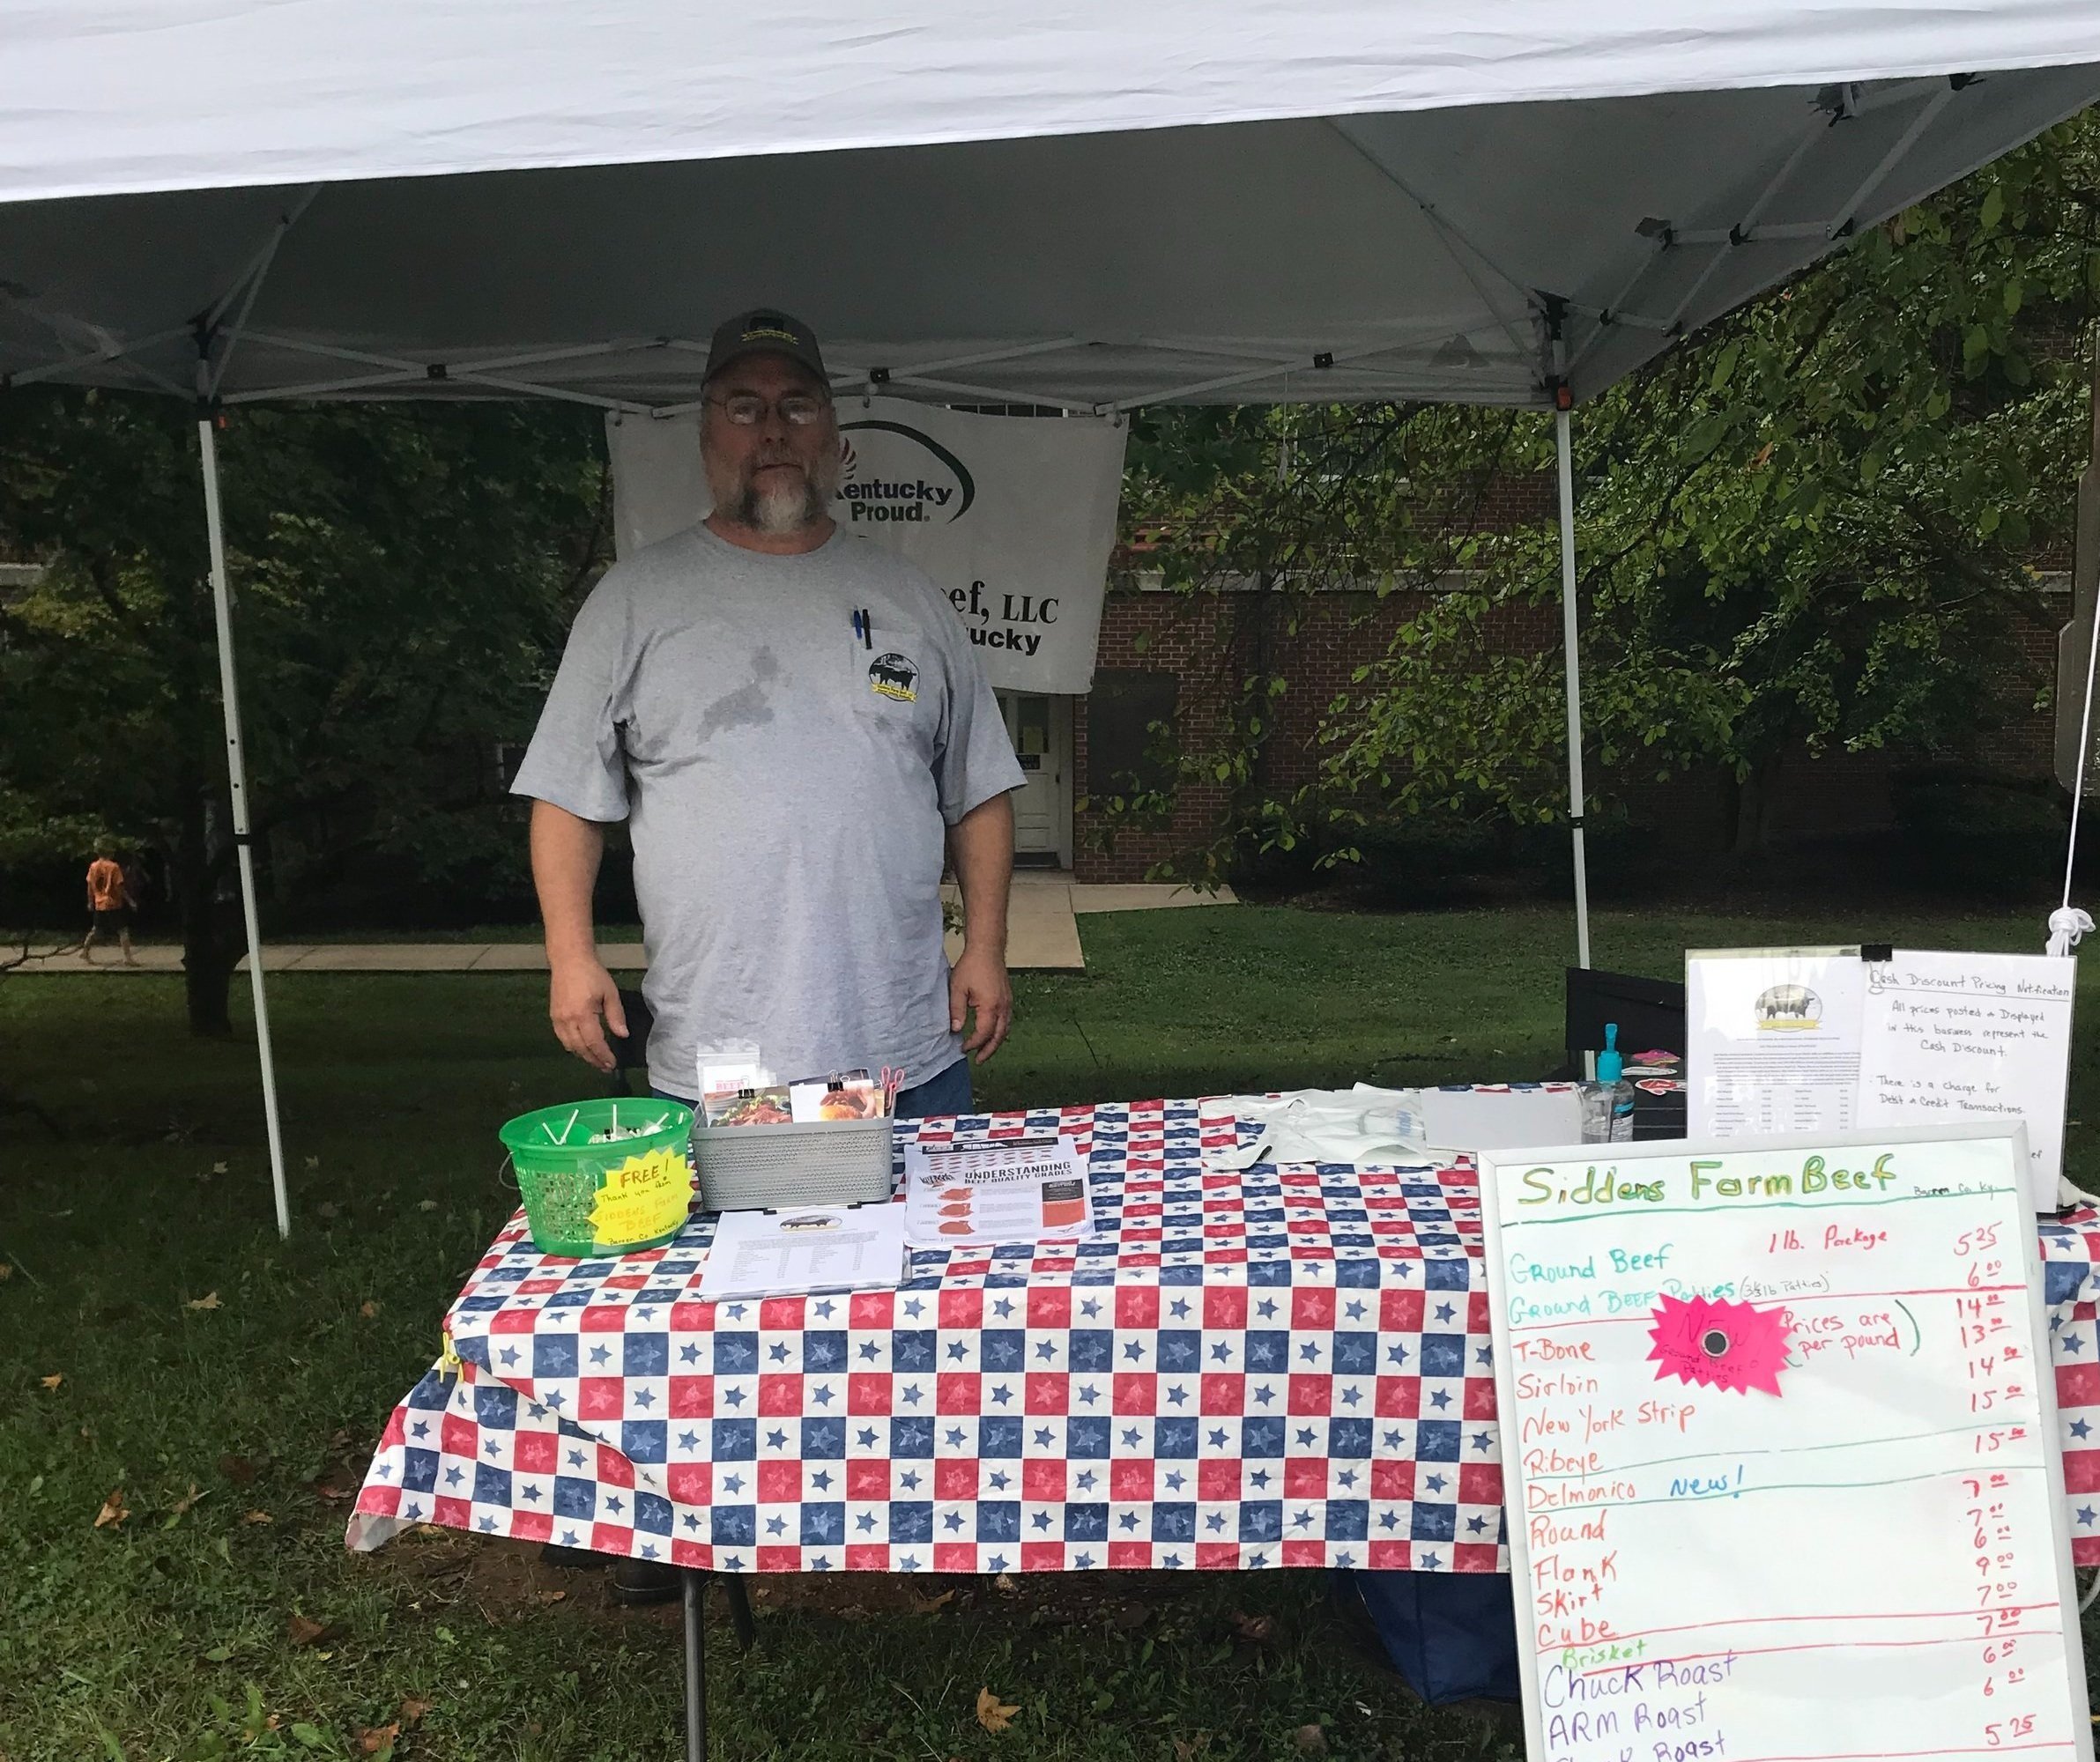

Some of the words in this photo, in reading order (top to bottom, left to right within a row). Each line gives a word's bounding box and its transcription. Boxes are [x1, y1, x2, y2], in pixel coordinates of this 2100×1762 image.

[1001, 594, 1058, 624] LLC
[966, 628, 1042, 655] ucky
[1870, 970, 1900, 986] Cash
[1906, 974, 1966, 988] Discount
[1971, 977, 2006, 995] Pricing
[1892, 1000, 1905, 1012] All
[1910, 1005, 1940, 1018] prices
[1946, 1006, 1981, 1018] posted
[2000, 1009, 2044, 1023] Displayed
[1933, 1025, 1972, 1037] business
[1983, 1030, 2025, 1040] represent
[2031, 1031, 2048, 1040] the
[1920, 1040, 1946, 1053] Cash
[1879, 1093, 1903, 1105] Debit
[1919, 1096, 1948, 1108] Credit
[1985, 1083, 2000, 1093] for
[965, 1161, 1071, 1180] UNDERSTANDING
[991, 1173, 1031, 1183] QUALITY
[1035, 1169, 1072, 1178] GRADES
[1517, 1166, 1666, 1204] Siddens
[1691, 1161, 1792, 1199] Farm
[1802, 1152, 1896, 1194] Beef
[600, 1192, 627, 1203] Thank
[634, 1188, 649, 1197] you
[619, 1212, 662, 1232] BEEF
[1824, 1225, 1888, 1250] Package
[1609, 1243, 1673, 1273] Beef
[1859, 1313, 1889, 1328] are
[1513, 1337, 1596, 1362] T-Bone
[1799, 1338, 1833, 1359] per
[1841, 1327, 1900, 1359] pound
[1516, 1373, 1599, 1399] Sirloin
[1523, 1407, 1569, 1443] New
[1637, 1401, 1695, 1433] Strip
[1524, 1448, 1604, 1484] Ribeye
[1528, 1483, 1636, 1510] Delmonico
[1670, 1464, 1742, 1499] New!
[1531, 1508, 1607, 1550] Round
[1562, 1640, 1647, 1669] Brisket
[1653, 1649, 1737, 1690] Roast
[1549, 1711, 1618, 1750] ARM
[1634, 1692, 1706, 1732] Roast
